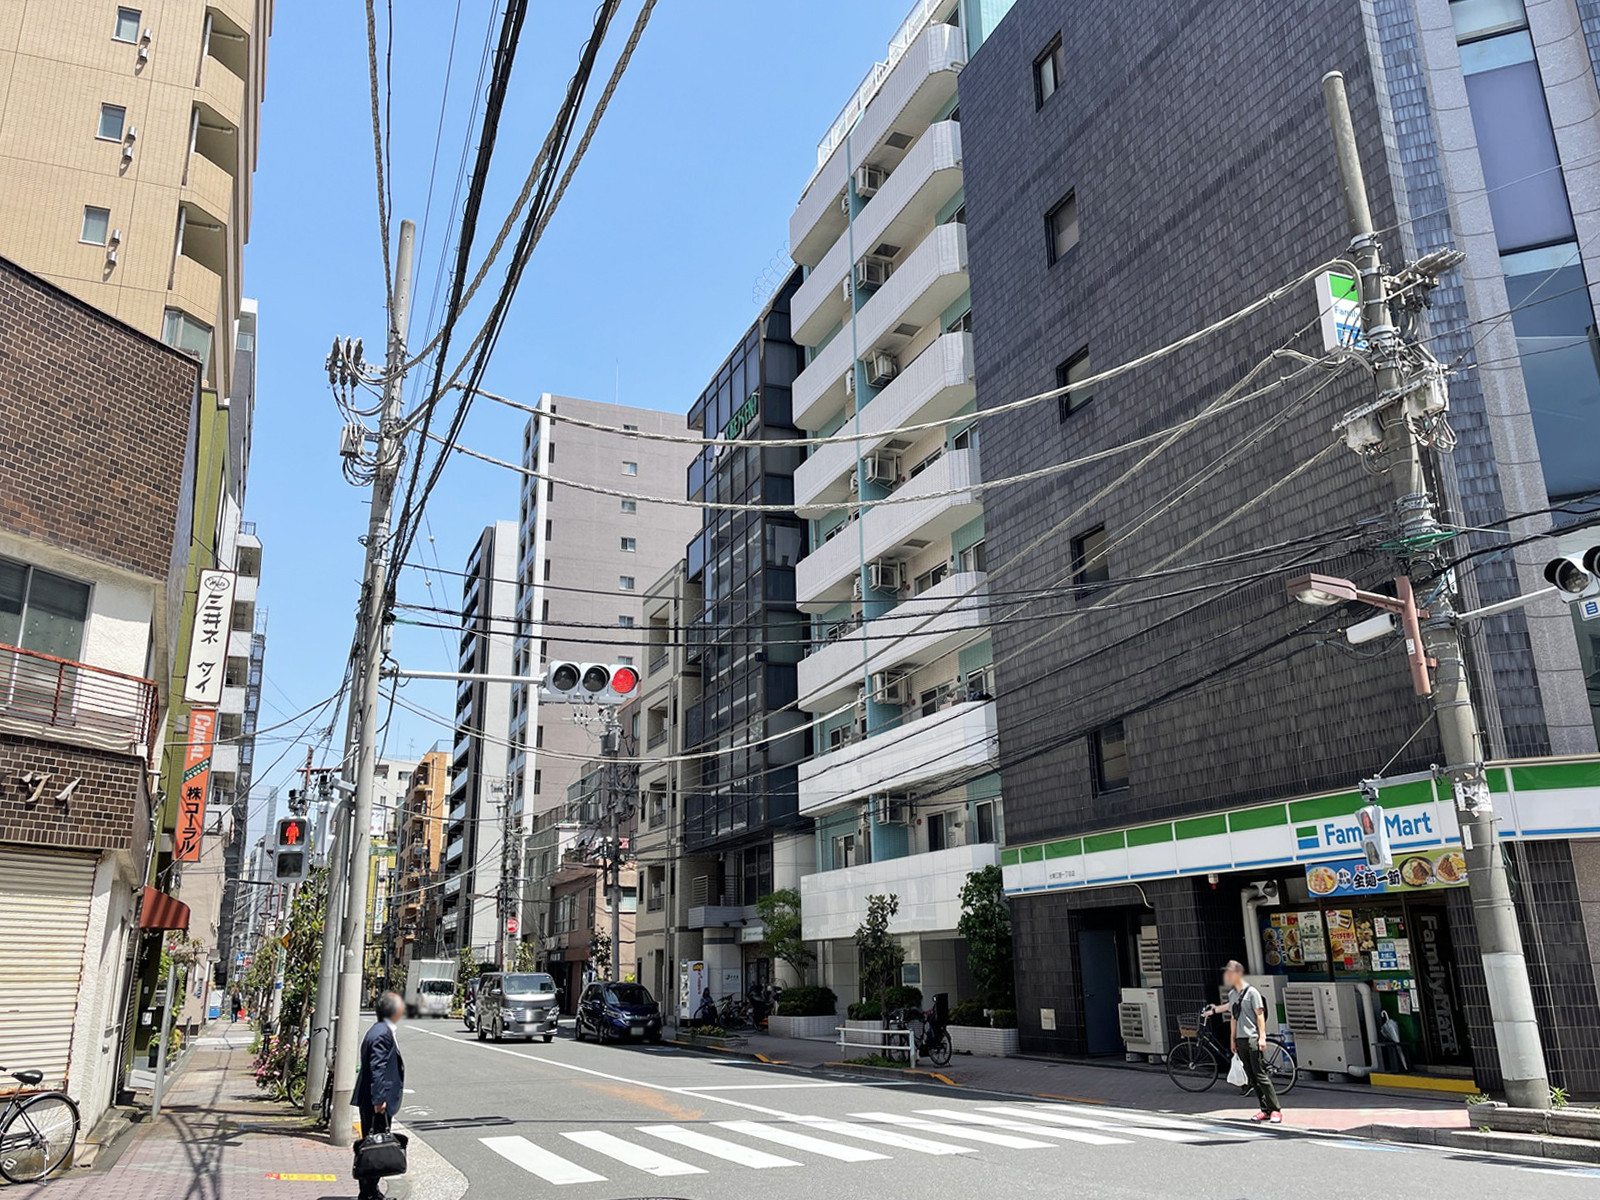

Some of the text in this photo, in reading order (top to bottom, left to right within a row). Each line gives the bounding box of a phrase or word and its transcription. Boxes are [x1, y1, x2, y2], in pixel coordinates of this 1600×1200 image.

[1353, 870, 1401, 888] 全麺一新
[1420, 915, 1459, 1056] FamilyMart
